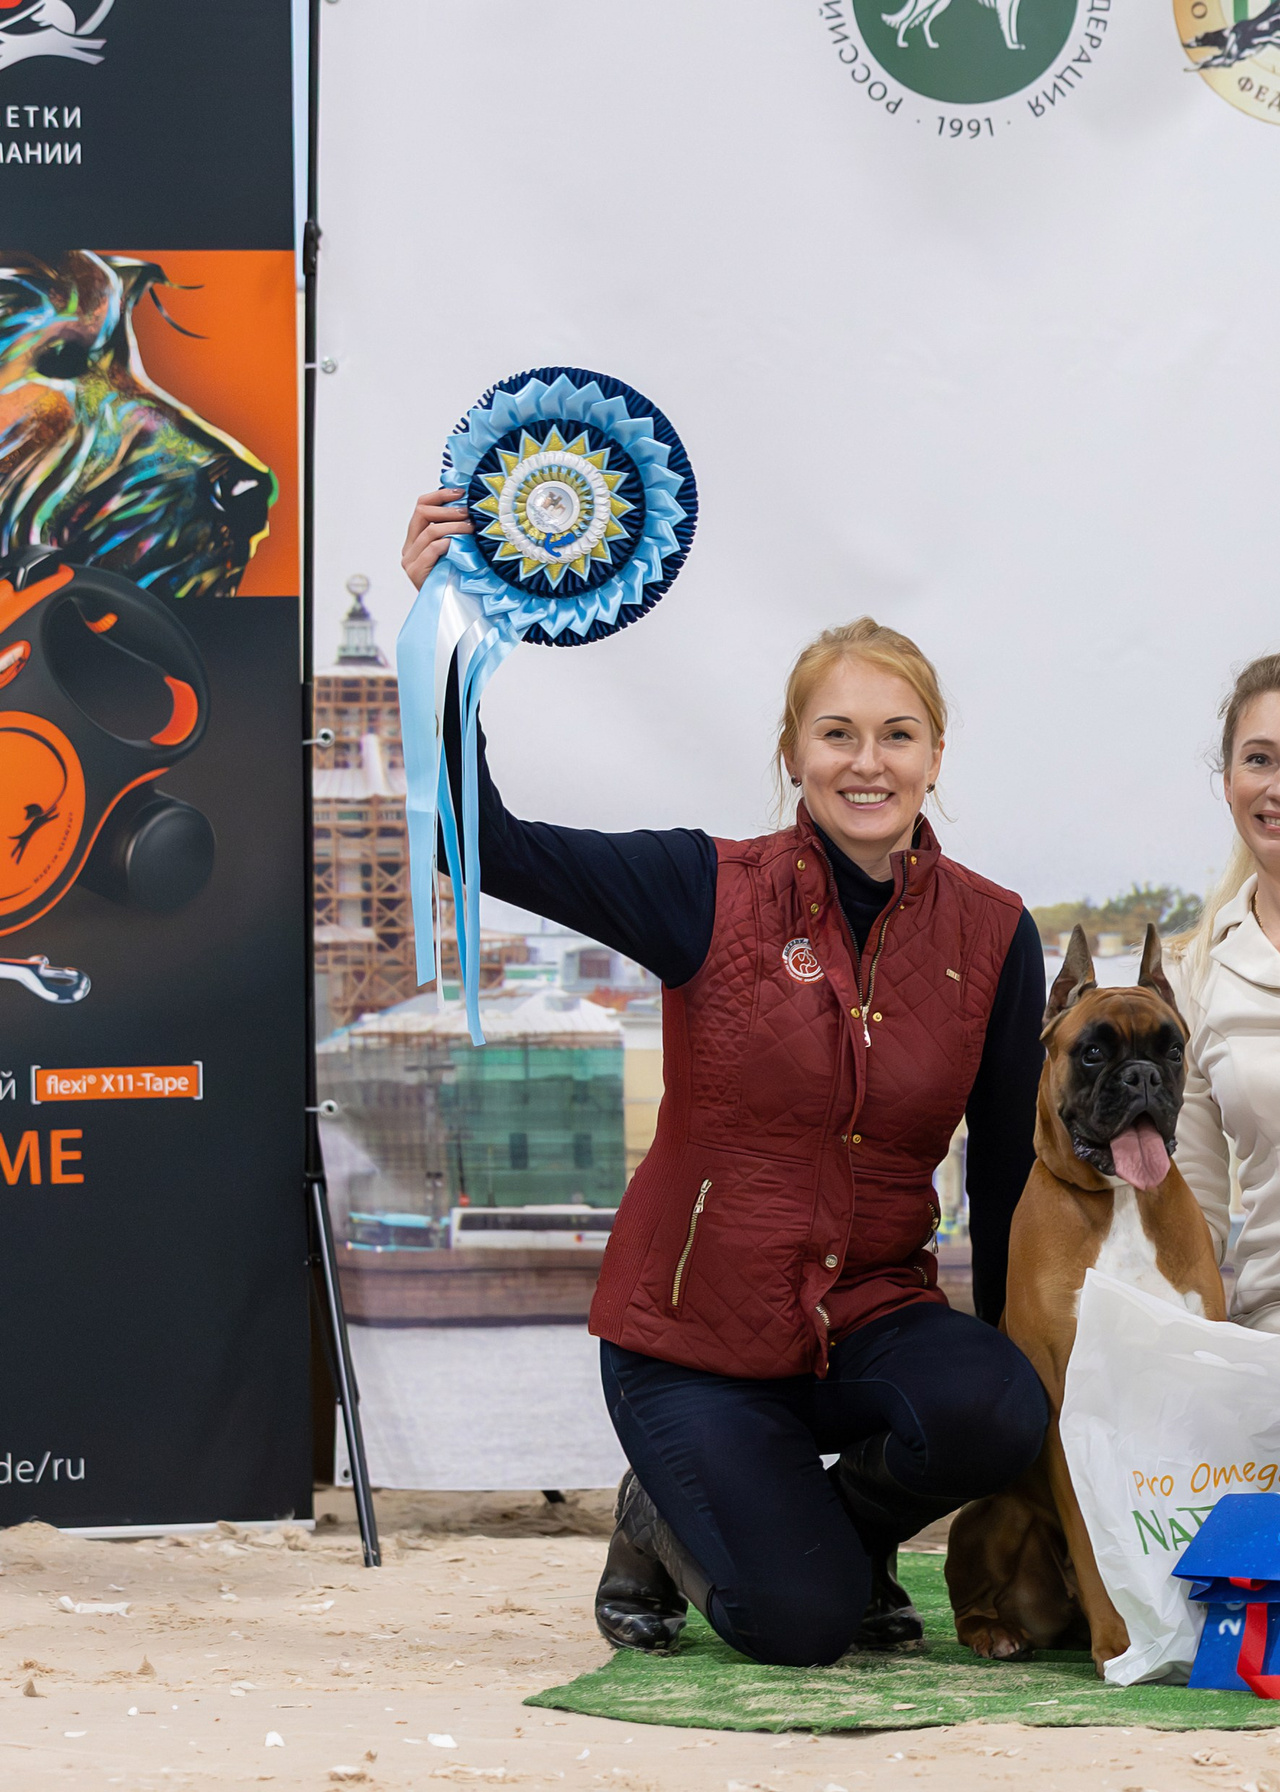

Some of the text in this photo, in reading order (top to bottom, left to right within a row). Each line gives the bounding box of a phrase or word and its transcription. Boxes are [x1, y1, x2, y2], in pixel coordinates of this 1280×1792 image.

[937, 116, 995, 139] 1991
[0, 141, 82, 164] АНИИ
[101, 1073, 189, 1095] X11-Tape
[1132, 1470, 1174, 1497] Pro
